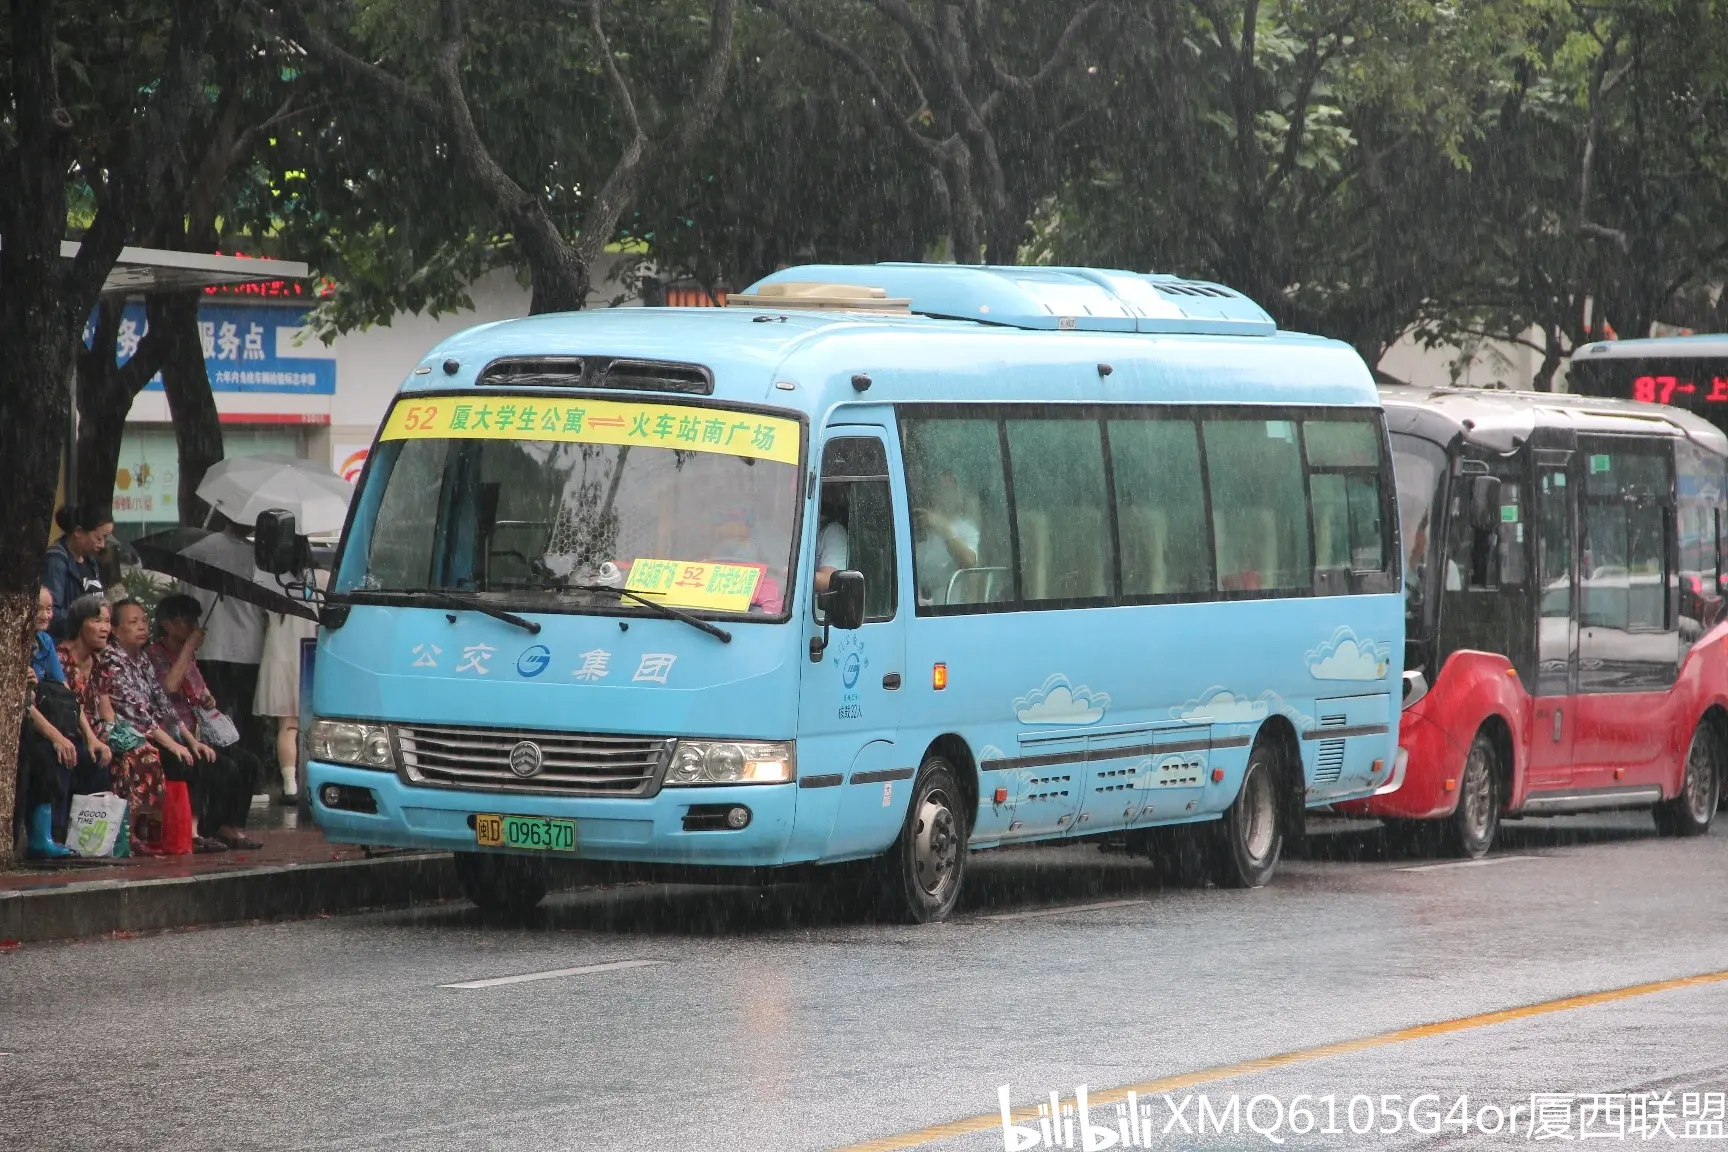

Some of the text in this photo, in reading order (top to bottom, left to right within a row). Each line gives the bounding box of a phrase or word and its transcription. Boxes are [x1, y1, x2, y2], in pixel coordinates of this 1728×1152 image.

[1634, 376, 1677, 404] 87
[404, 406, 438, 431] 52
[449, 404, 776, 451] 厦大学生公寓 火车站南广场
[683, 566, 705, 581] 52
[411, 642, 678, 684] 公交 集团
[78, 810, 106, 818] #GOOD
